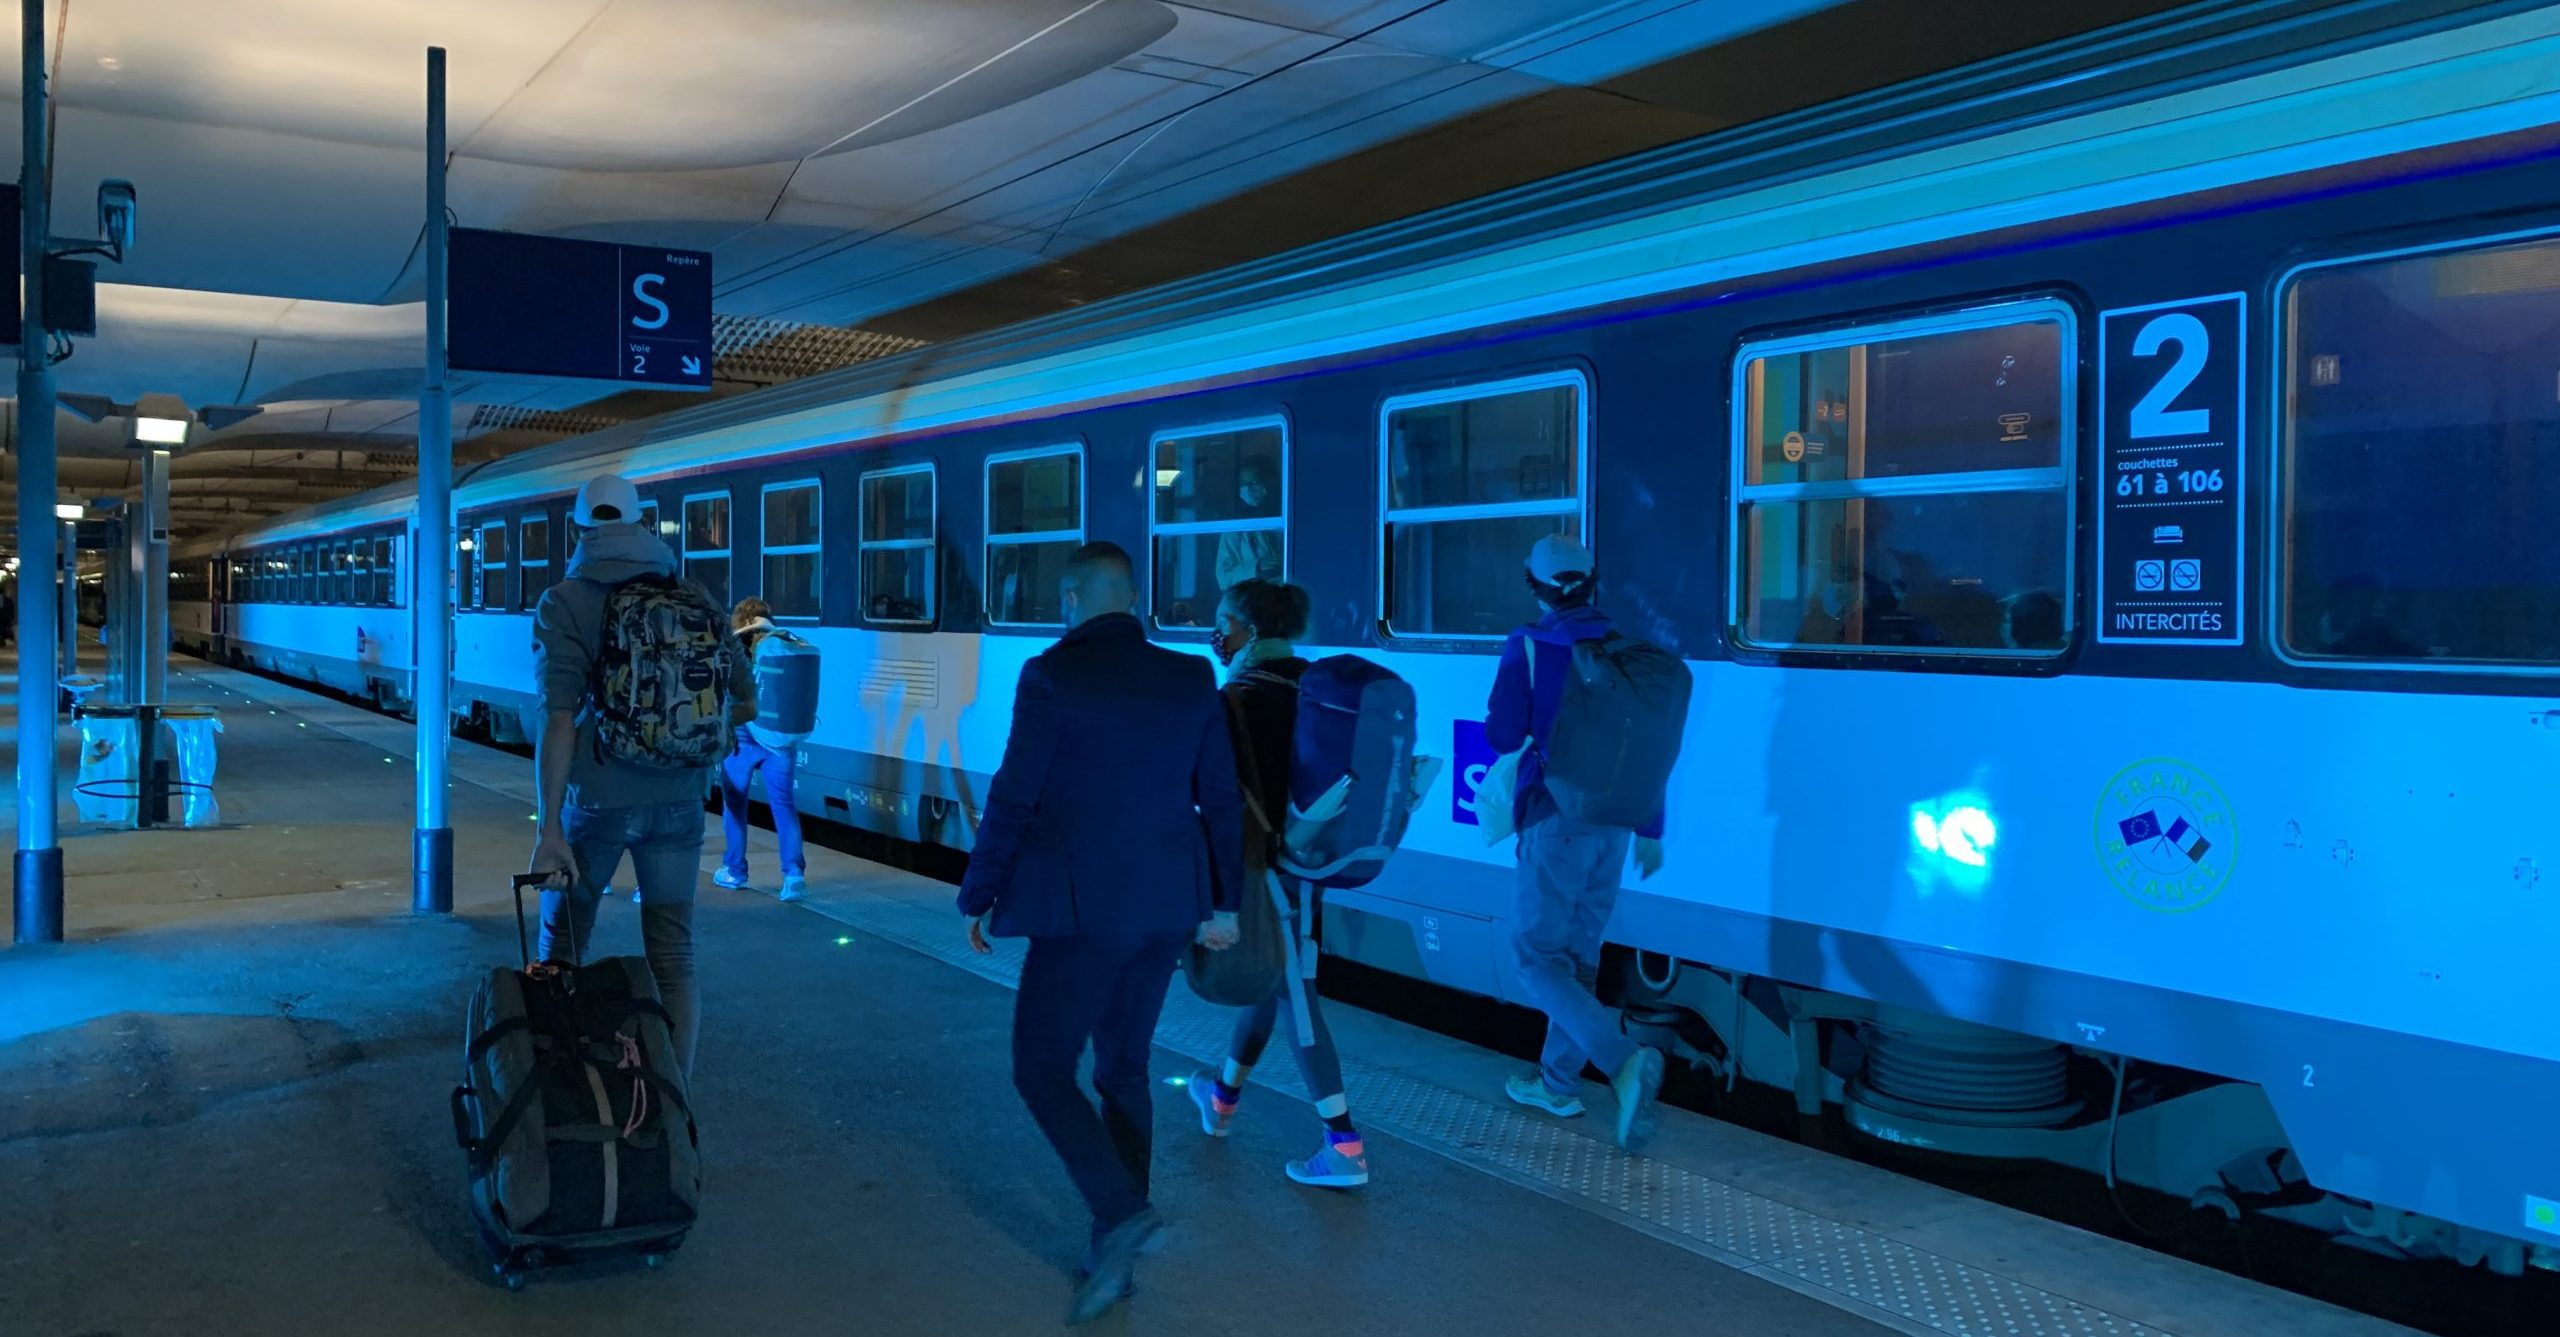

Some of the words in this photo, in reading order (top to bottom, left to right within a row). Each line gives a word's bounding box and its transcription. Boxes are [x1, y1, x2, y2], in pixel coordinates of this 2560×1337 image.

[666, 254, 700, 266] Repère
[632, 273, 669, 329] S
[629, 343, 651, 354] Voie
[633, 355, 646, 374] 2
[2130, 313, 2210, 439] 2
[2118, 456, 2179, 471] couchettes
[2116, 474, 2145, 497] 61
[2154, 473, 2168, 495] à
[2178, 469, 2224, 494] 106
[2115, 609, 2222, 631] INTERCITÉS
[2115, 770, 2221, 828] FRANCE
[2105, 838, 2220, 903] RELANCE
[2302, 1064, 2315, 1087] 2
